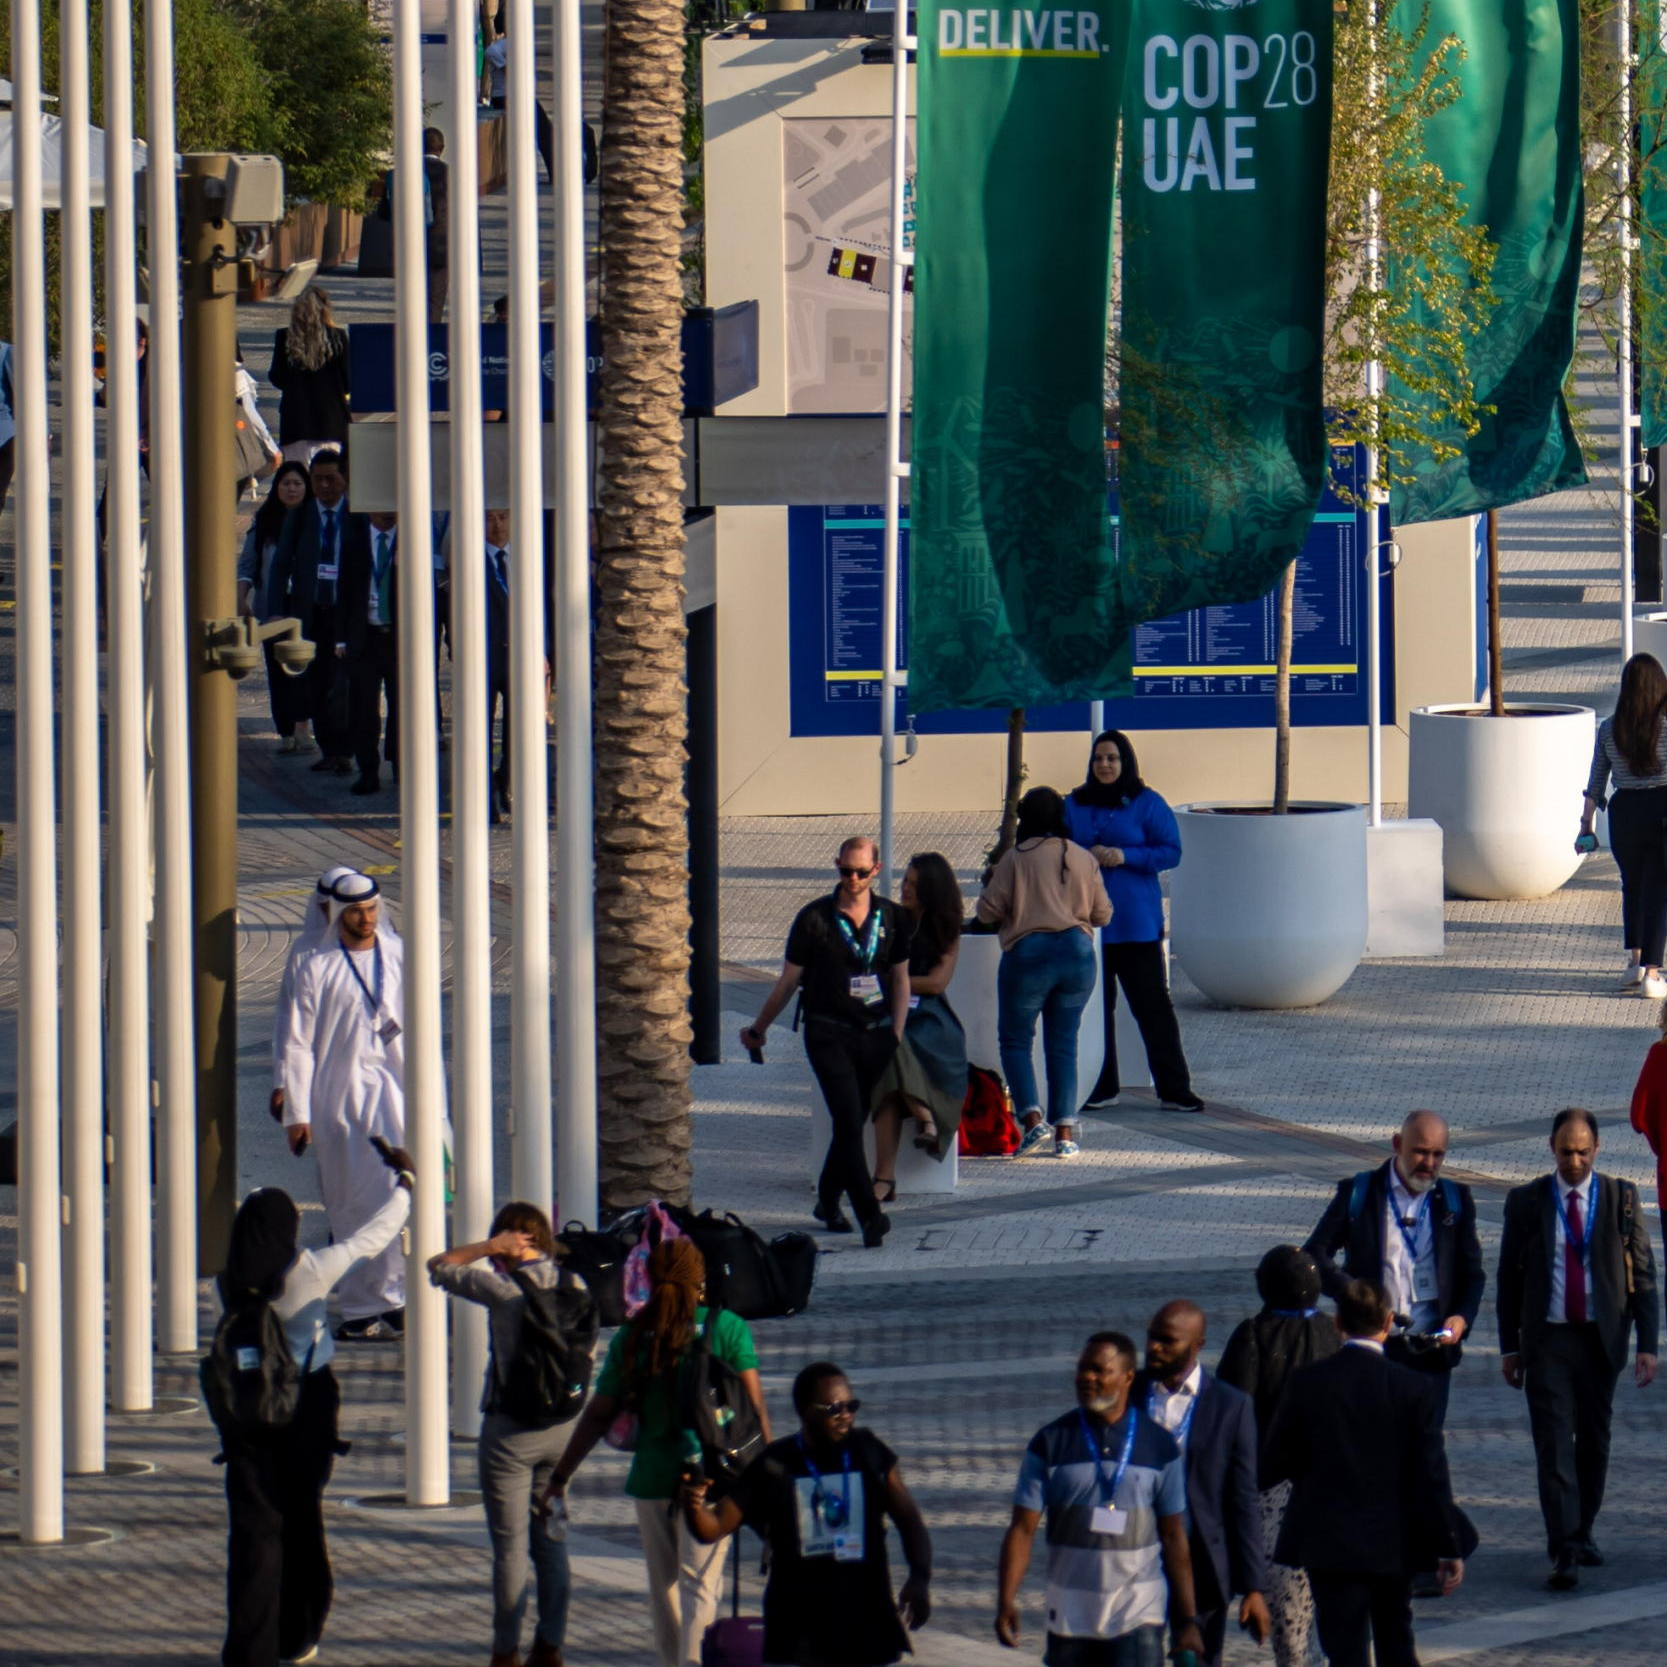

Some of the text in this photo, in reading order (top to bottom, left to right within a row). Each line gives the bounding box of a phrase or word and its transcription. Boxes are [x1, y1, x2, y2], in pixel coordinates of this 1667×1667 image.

[937, 10, 1110, 53] DELIVER.
[1143, 31, 1319, 113] COP28
[1143, 115, 1258, 193] UAE
